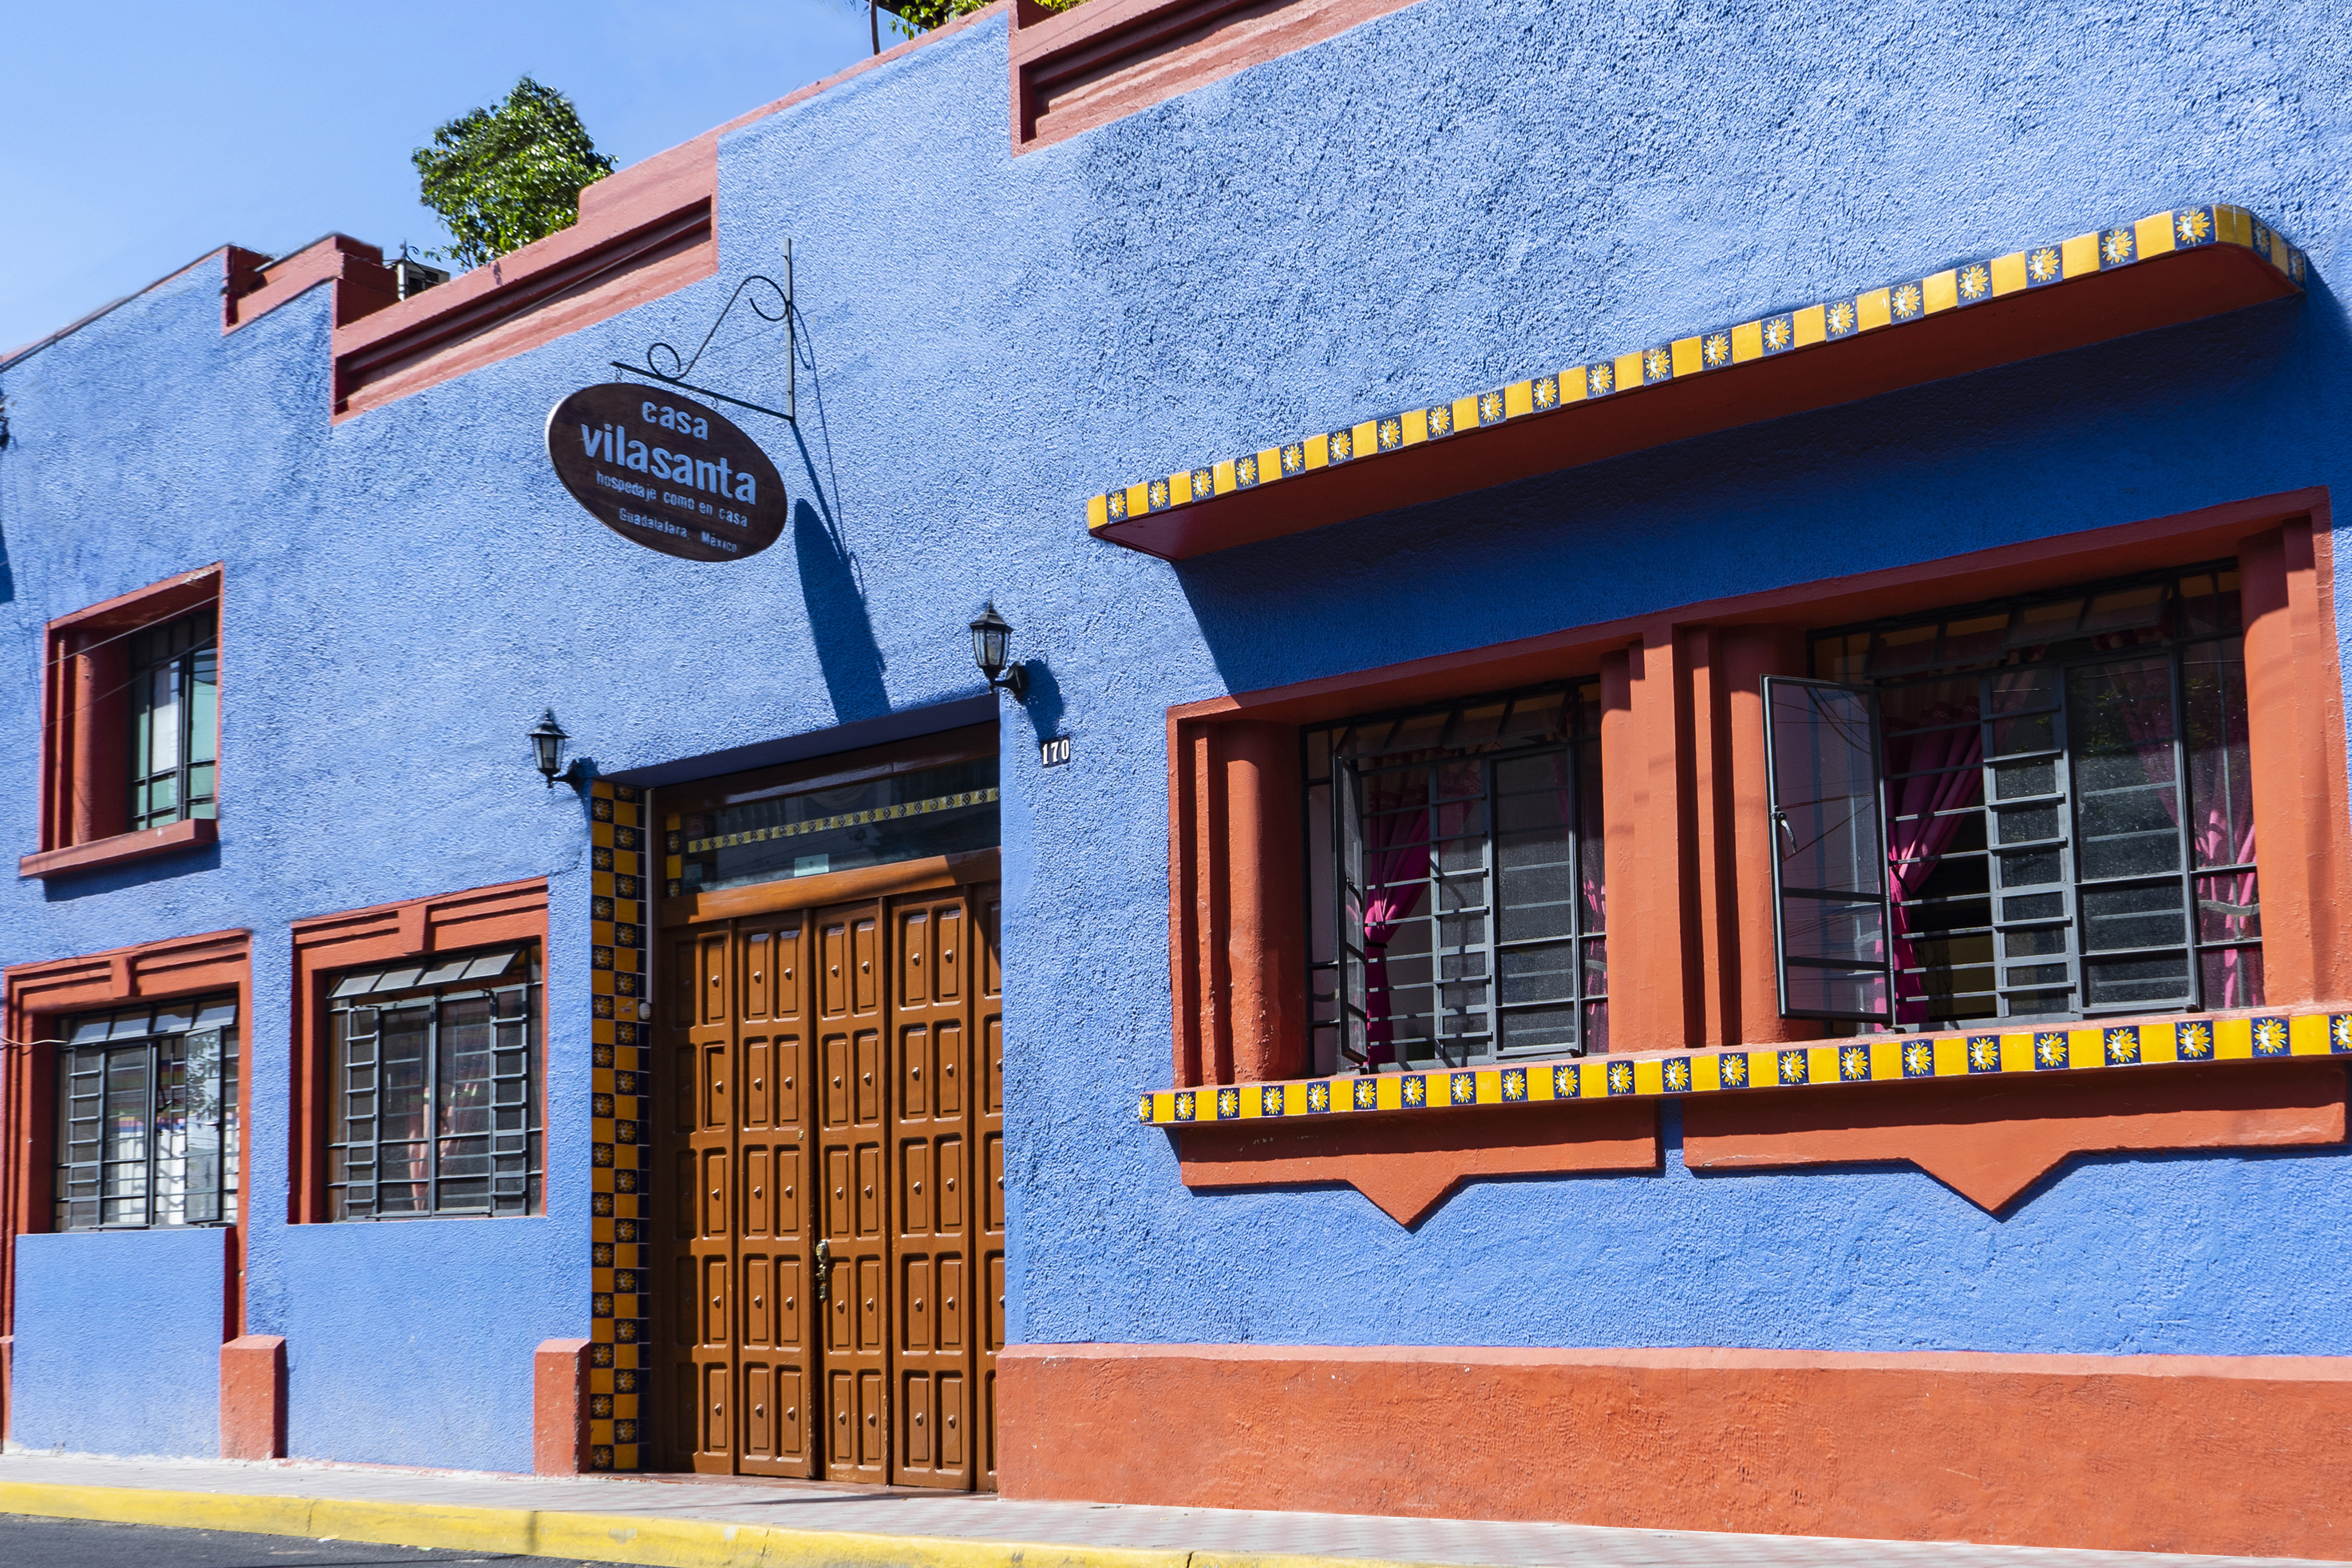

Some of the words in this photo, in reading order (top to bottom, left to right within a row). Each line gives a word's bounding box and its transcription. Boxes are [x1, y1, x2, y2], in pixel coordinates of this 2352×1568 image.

[642, 401, 708, 440] casa
[581, 423, 756, 505] vilasanta
[596, 470, 657, 501] hospedaje
[664, 491, 695, 510] como
[699, 502, 713, 516] en
[719, 508, 748, 527] casa
[1043, 740, 1069, 764] 170
